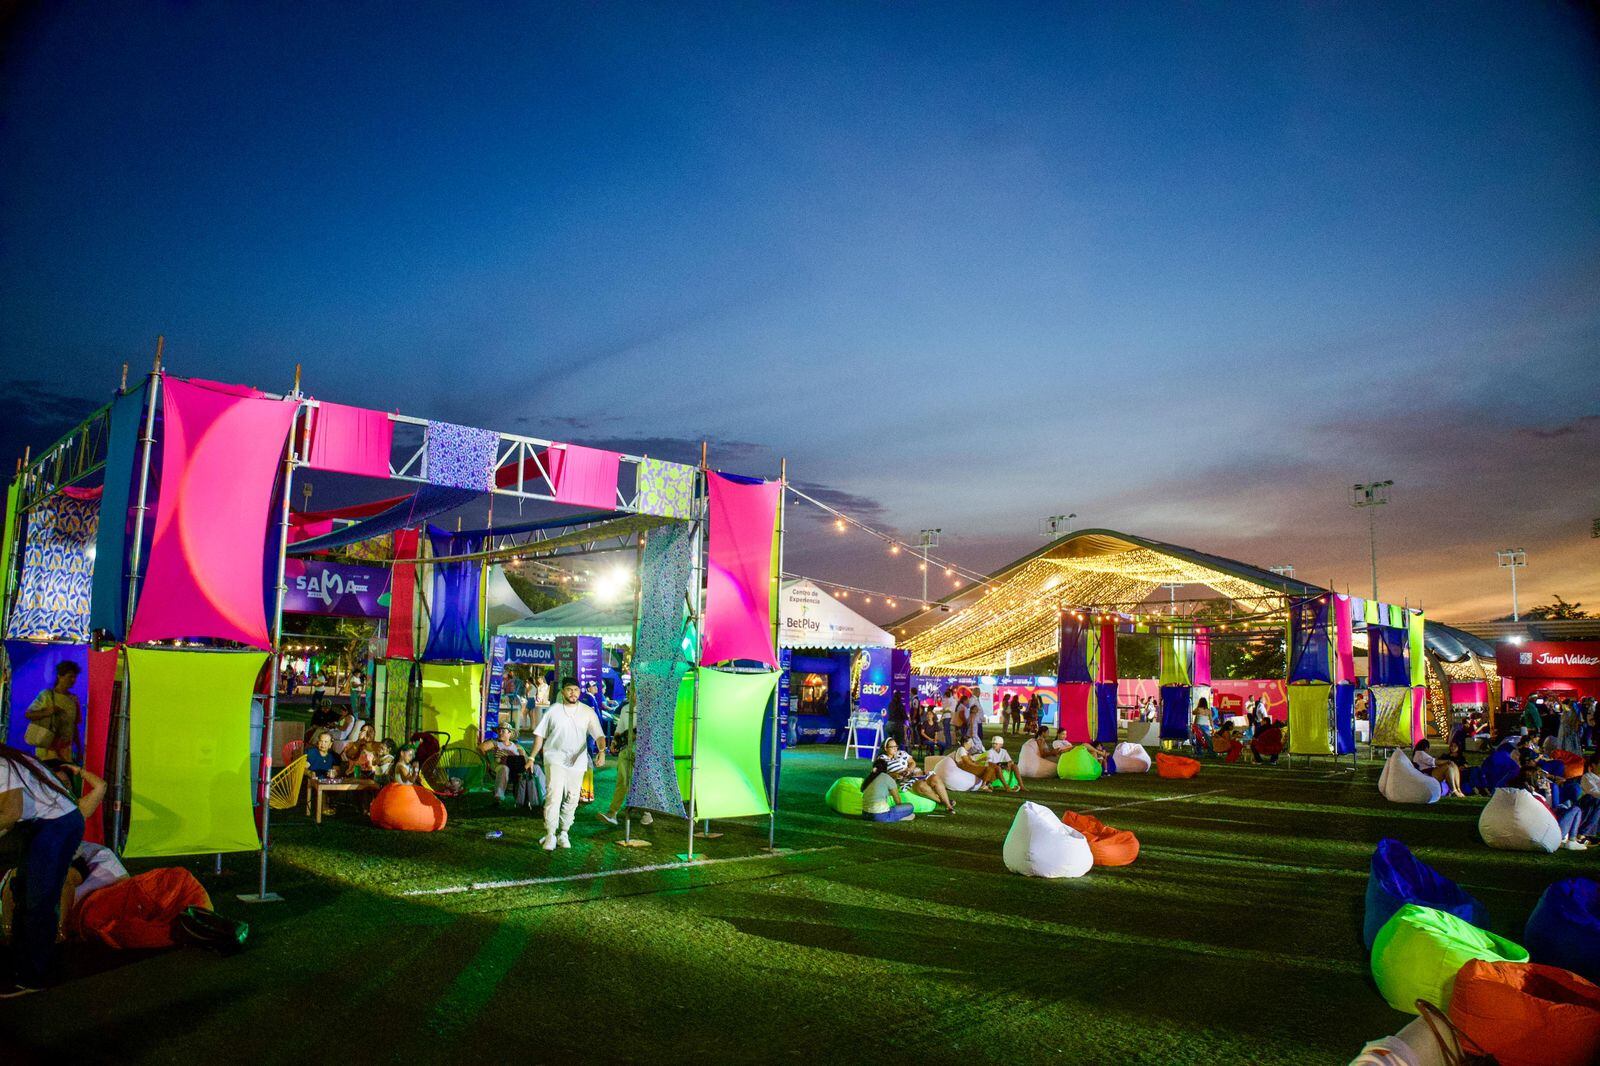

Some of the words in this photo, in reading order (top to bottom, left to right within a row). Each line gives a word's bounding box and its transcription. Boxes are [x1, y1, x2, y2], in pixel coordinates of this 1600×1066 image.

[789, 596, 820, 604] Experiencia
[787, 617, 820, 631] BetPlay
[515, 648, 551, 659] DAABON
[1536, 652, 1564, 665] Juan
[1564, 653, 1600, 666] Valdez
